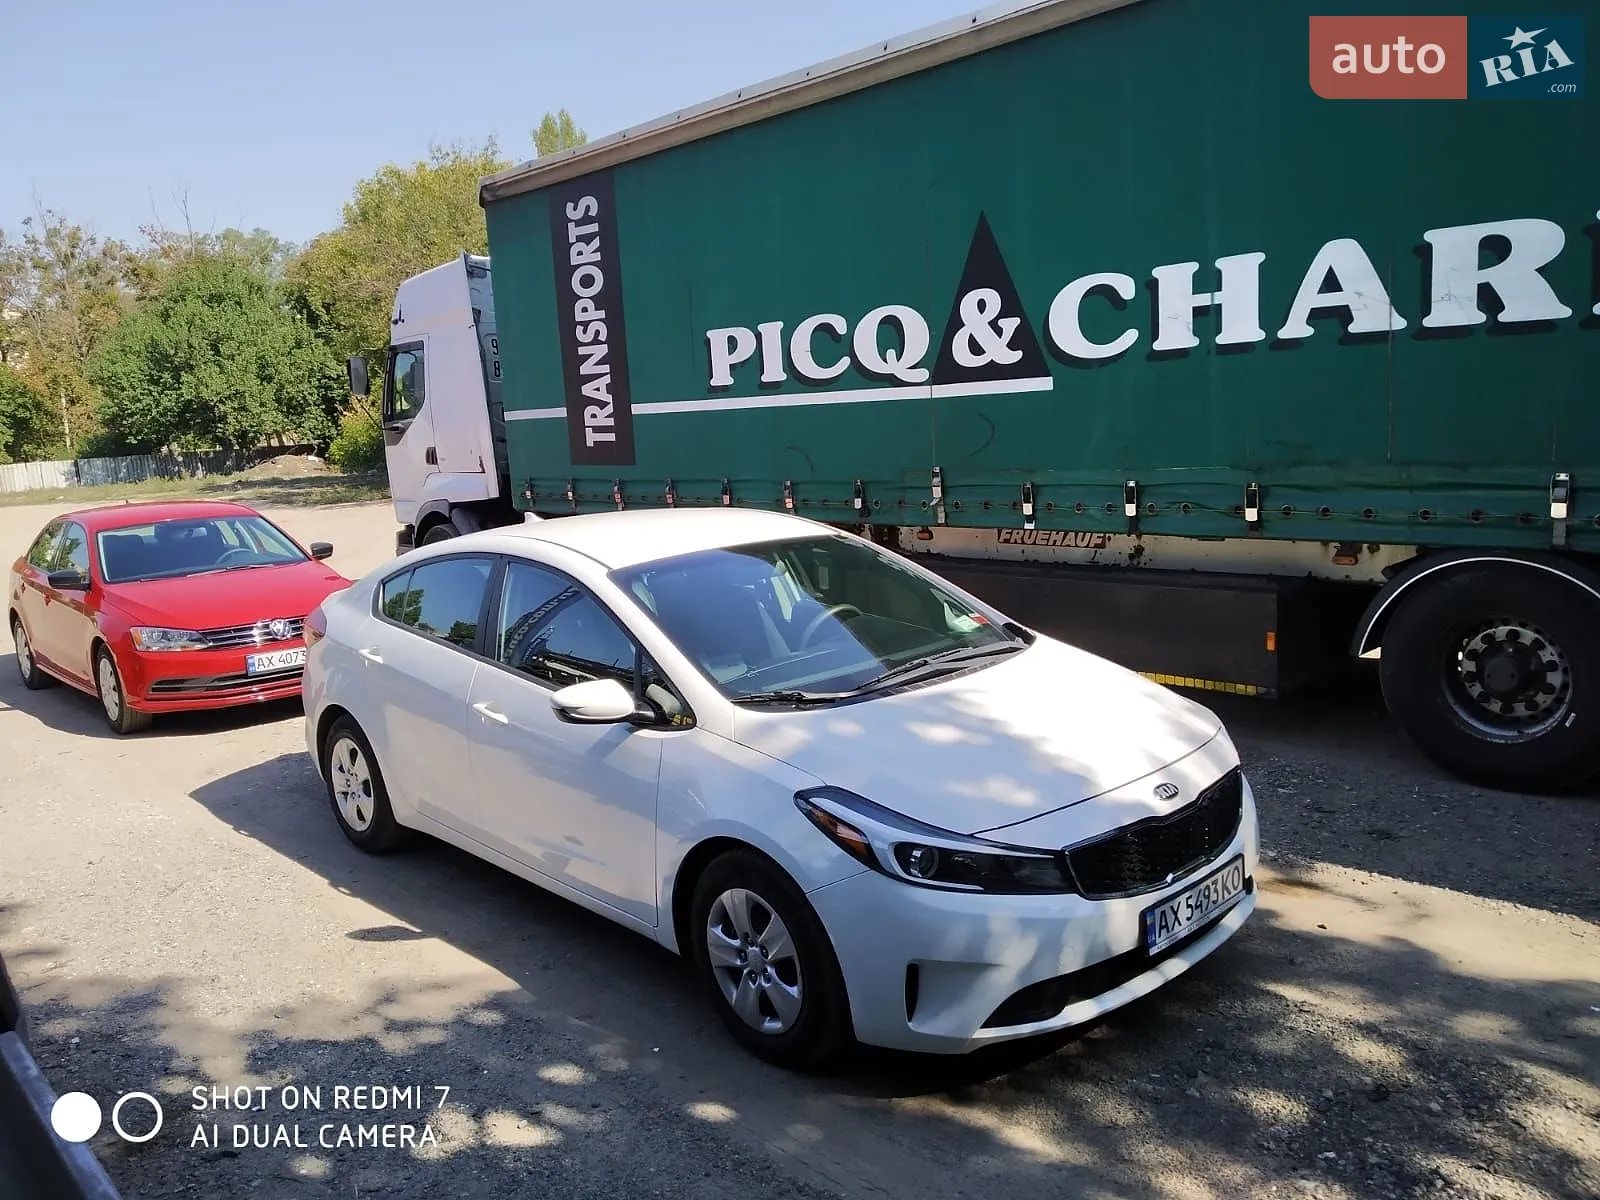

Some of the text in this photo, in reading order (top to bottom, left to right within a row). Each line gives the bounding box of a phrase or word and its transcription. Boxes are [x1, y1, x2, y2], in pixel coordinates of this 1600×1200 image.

[566, 195, 617, 447] TRANSPORTS
[706, 209, 1600, 386] PICQ & CHAR
[998, 528, 1106, 549] FRUEHAUF
[257, 656, 275, 670] AX
[1158, 901, 1182, 938] AX
[1186, 878, 1219, 921] 5493
[1221, 865, 1241, 900] KO
